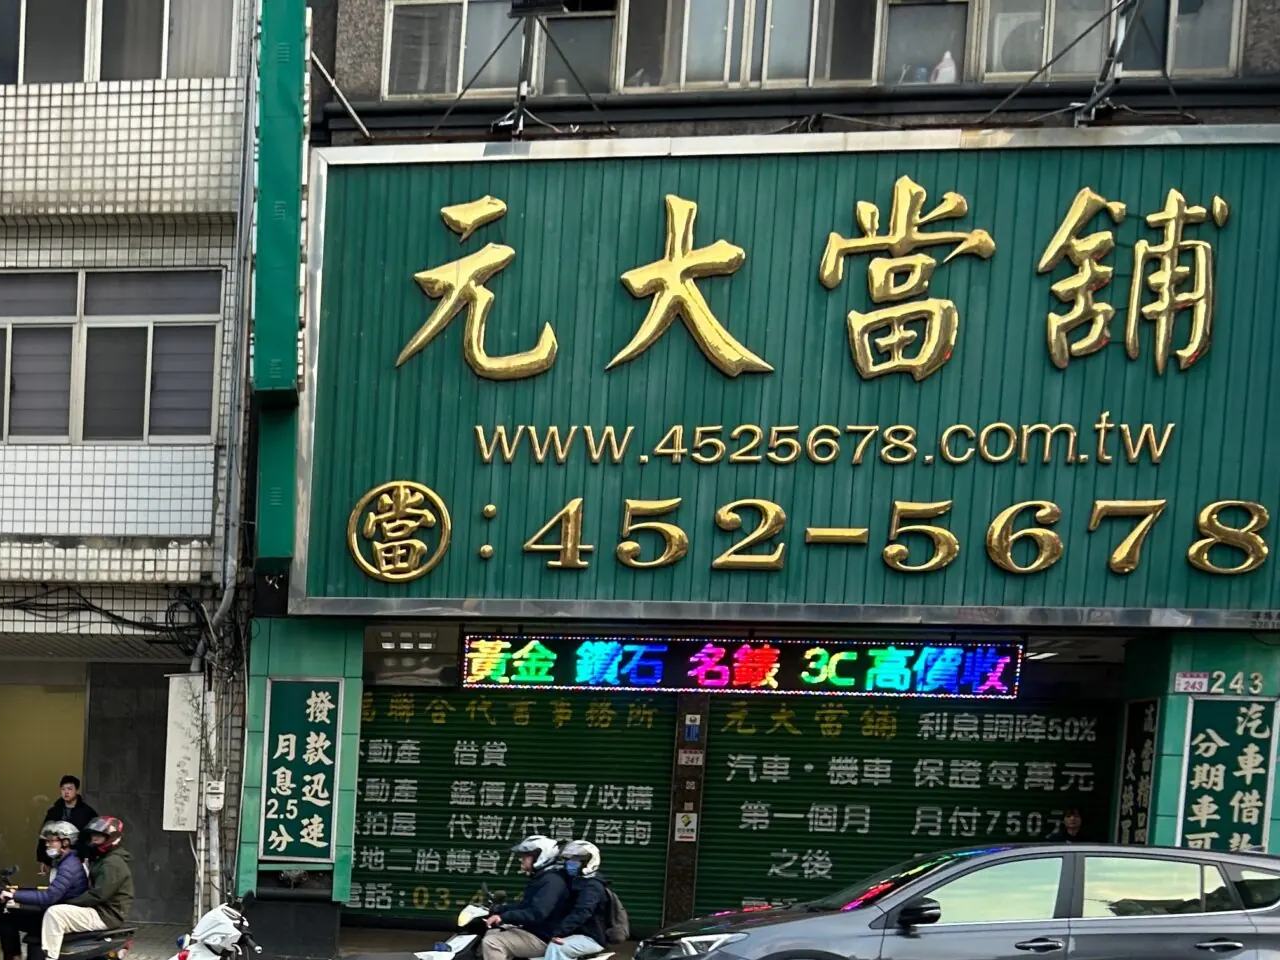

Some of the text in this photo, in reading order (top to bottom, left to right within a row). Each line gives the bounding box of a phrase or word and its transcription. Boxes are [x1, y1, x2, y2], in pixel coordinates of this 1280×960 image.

[394, 174, 1230, 381] 元大當舖
[473, 411, 1176, 467] www.4525678.com.tw
[466, 640, 557, 684] 黃金
[575, 640, 668, 685] 鑽石
[1210, 671, 1264, 694] 243
[359, 739, 421, 764] 動產
[300, 690, 336, 849] 撥款迅速
[356, 778, 418, 803] 動產
[354, 811, 417, 837] 拍屋
[738, 800, 871, 834] 第一個月
[766, 848, 834, 880] 之後
